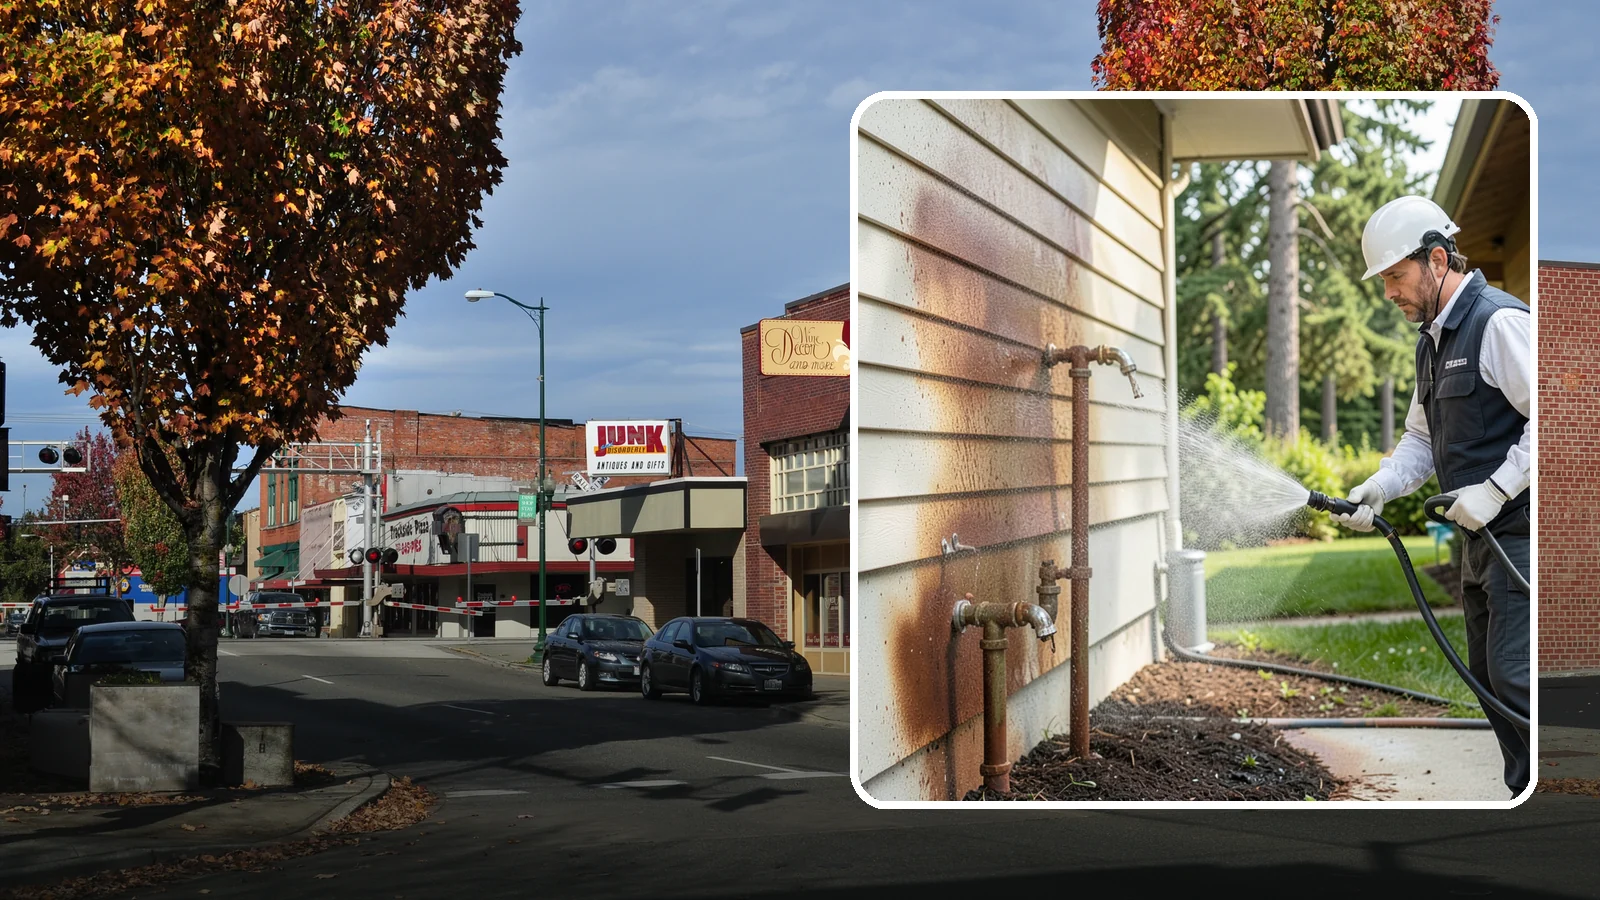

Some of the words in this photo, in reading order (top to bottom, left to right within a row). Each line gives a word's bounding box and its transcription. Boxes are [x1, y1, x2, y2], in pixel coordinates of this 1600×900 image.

[595, 425, 665, 457] JUNK
[597, 461, 628, 470] ANTIQUES
[631, 461, 644, 470] AND
[647, 461, 665, 469] GIFTS
[414, 519, 429, 534] Pizza
